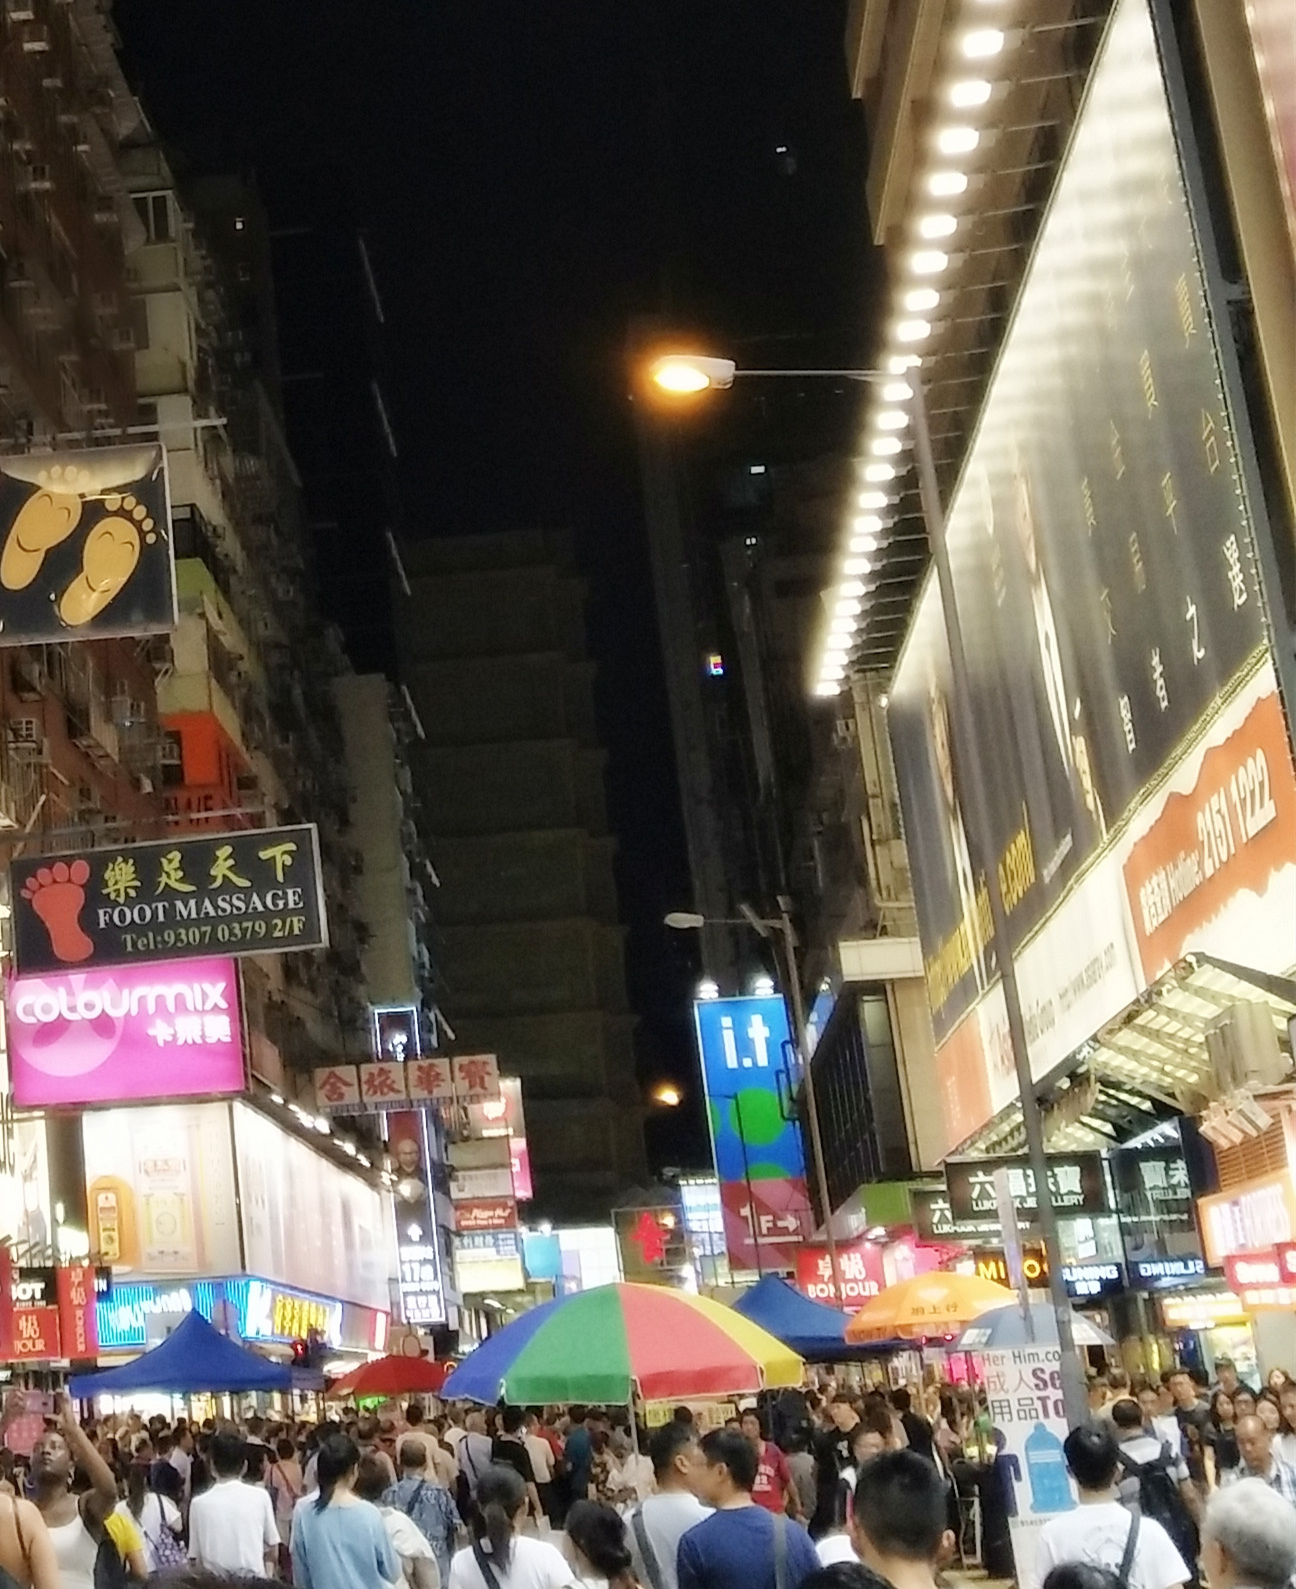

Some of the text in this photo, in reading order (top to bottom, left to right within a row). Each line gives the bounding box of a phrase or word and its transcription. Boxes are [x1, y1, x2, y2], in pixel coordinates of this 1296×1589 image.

[1196, 785, 1236, 880] 2151
[1230, 746, 1277, 845] 1222
[100, 841, 298, 905] 樂足天下
[97, 887, 304, 930] FOOT MASSAGE
[121, 915, 306, 953] Tel:9307 0379 2/F
[720, 1013, 770, 1069] i.t
[1023, 1193, 1085, 1209] JELLERY
[981, 1347, 1061, 1368] Her Him.co
[985, 1366, 1062, 1395] 成人 Se
[990, 1395, 1066, 1424] 用品 To
